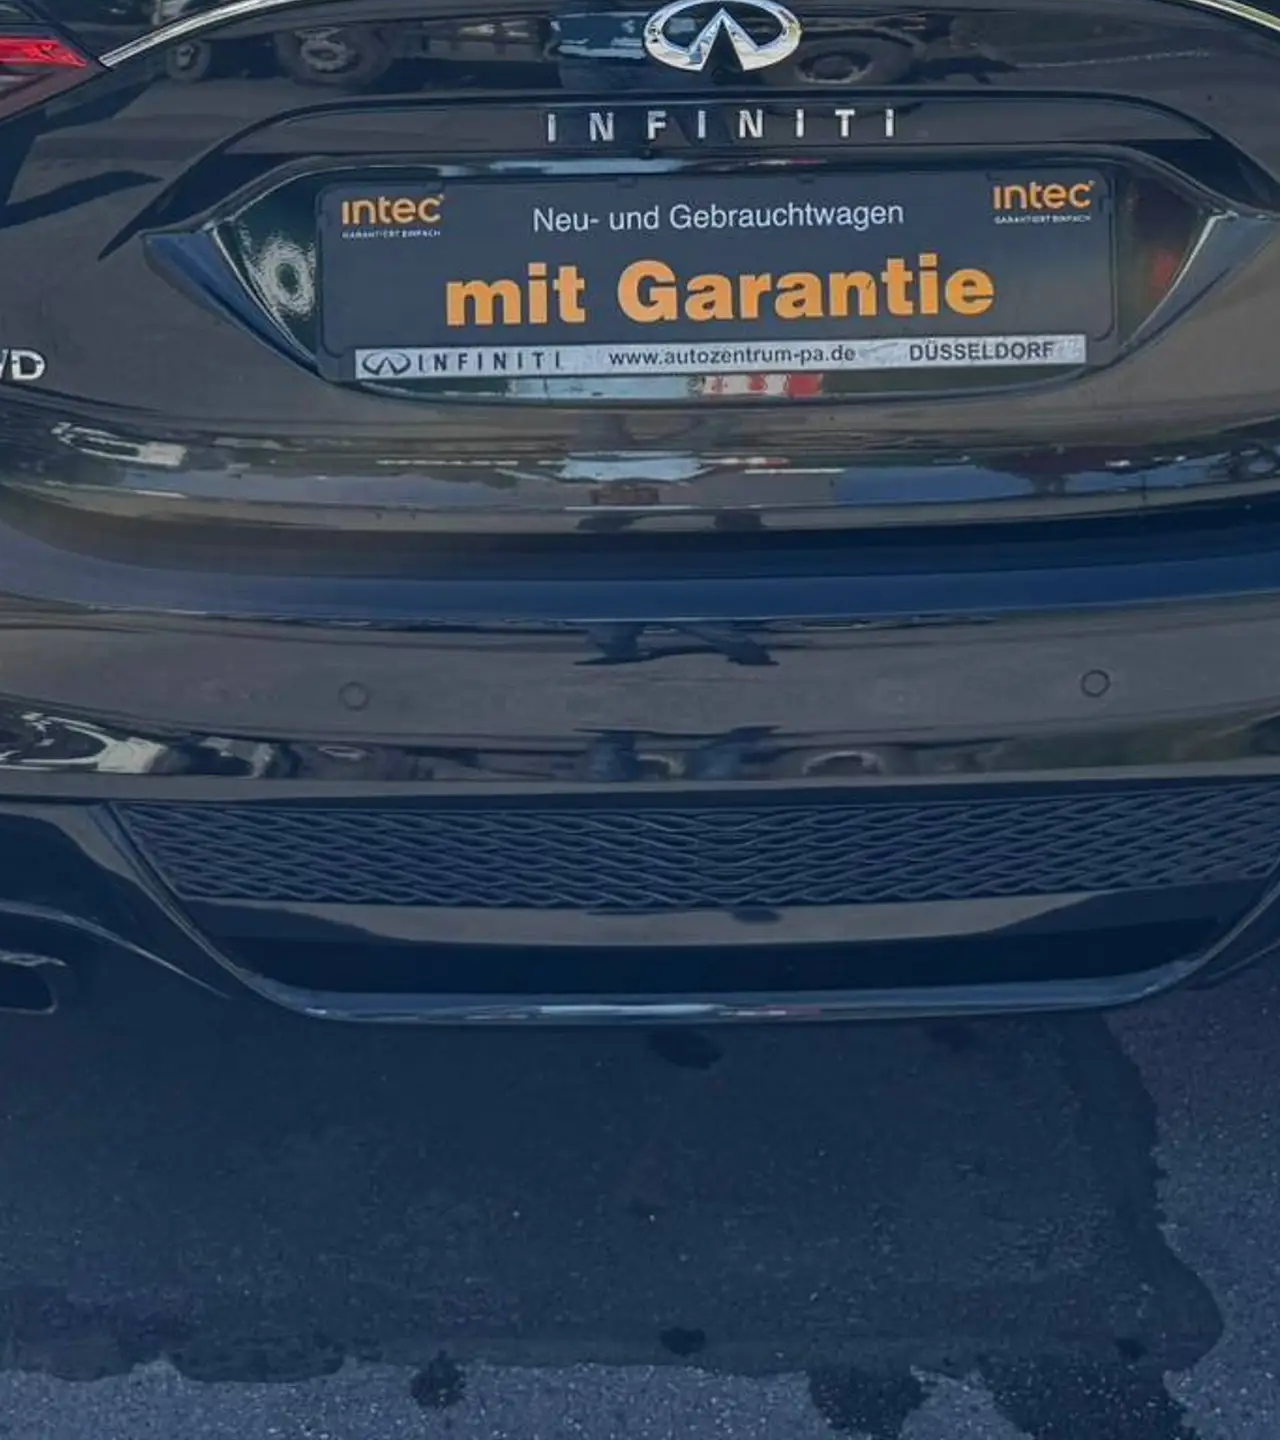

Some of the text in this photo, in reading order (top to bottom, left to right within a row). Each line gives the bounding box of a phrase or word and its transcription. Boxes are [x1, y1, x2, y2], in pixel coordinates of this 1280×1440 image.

[547, 109, 894, 142] INFINITI
[993, 181, 1091, 209] intec
[342, 195, 441, 224] intec
[533, 202, 904, 232] Neu- und Gebrauchtwagen
[446, 253, 995, 326] mit Garantie
[417, 352, 562, 372] INFINITI
[608, 345, 856, 367] www.autozentrum-pa.de
[909, 340, 1054, 361] DÜSSELDORF
